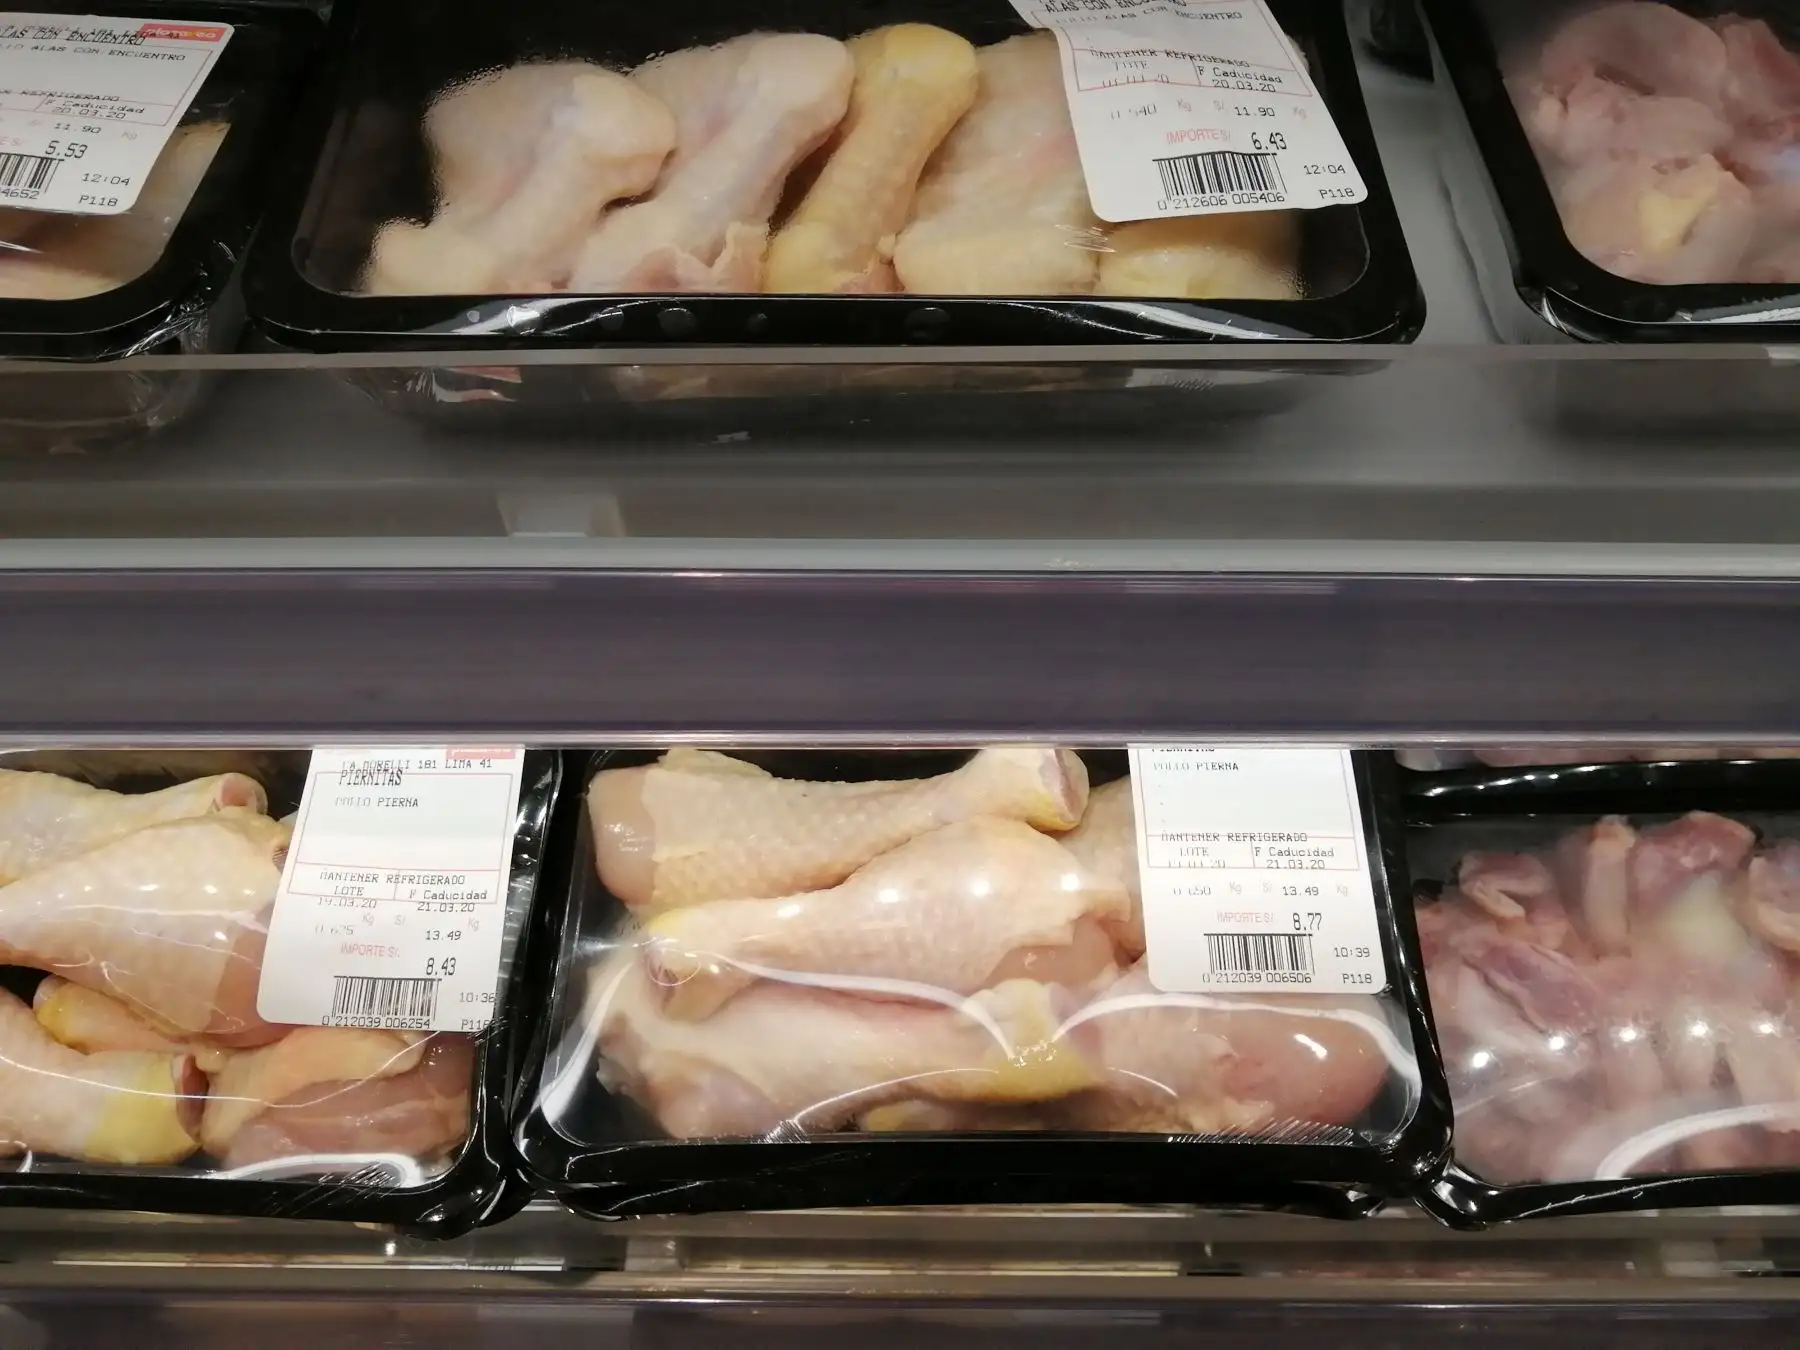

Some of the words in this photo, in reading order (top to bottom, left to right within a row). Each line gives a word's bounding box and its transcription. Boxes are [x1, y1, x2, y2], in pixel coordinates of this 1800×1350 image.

[108, 49, 186, 61] ENCUENTRO
[1212, 67, 1283, 84] Caducidad
[1212, 78, 1277, 93] 20.03.20
[62, 100, 145, 114] Caducidad
[1234, 106, 1276, 117] 11.90
[1251, 131, 1288, 150] 6.43
[45, 140, 88, 158] 5.53
[1303, 164, 1346, 175] 12:04
[82, 173, 130, 186] 12:04
[1319, 187, 1356, 200] P118
[78, 194, 118, 207] P118
[1173, 197, 1229, 210] 212606
[1232, 192, 1286, 206] 005406
[417, 760, 437, 769] 181
[445, 760, 473, 769] LIMA
[480, 759, 493, 768] 41
[1196, 762, 1239, 771] PIERNA
[339, 769, 403, 786] PIERNITAS
[377, 797, 419, 808] PIERNA
[1161, 832, 1221, 843] MANTENER
[1227, 833, 1308, 843] REFRIGERADO
[1269, 847, 1335, 858] Caducidad
[1266, 859, 1326, 870] 21.03.20
[320, 871, 379, 883] MANTENER
[386, 873, 465, 885] REFRIGERADO
[423, 890, 488, 900] Caducidad
[1282, 886, 1319, 896] 13.49
[417, 902, 475, 913] 21.03.20
[1292, 912, 1322, 931] 8.77
[425, 930, 462, 941] 13.49
[1334, 947, 1371, 958] 10:39
[426, 957, 457, 976] 8.43
[1216, 972, 1262, 983] 212039
[1266, 973, 1312, 984] 006506
[1343, 974, 1372, 985] P118
[335, 1016, 381, 1028] 212039
[385, 1017, 431, 1030] 006254
